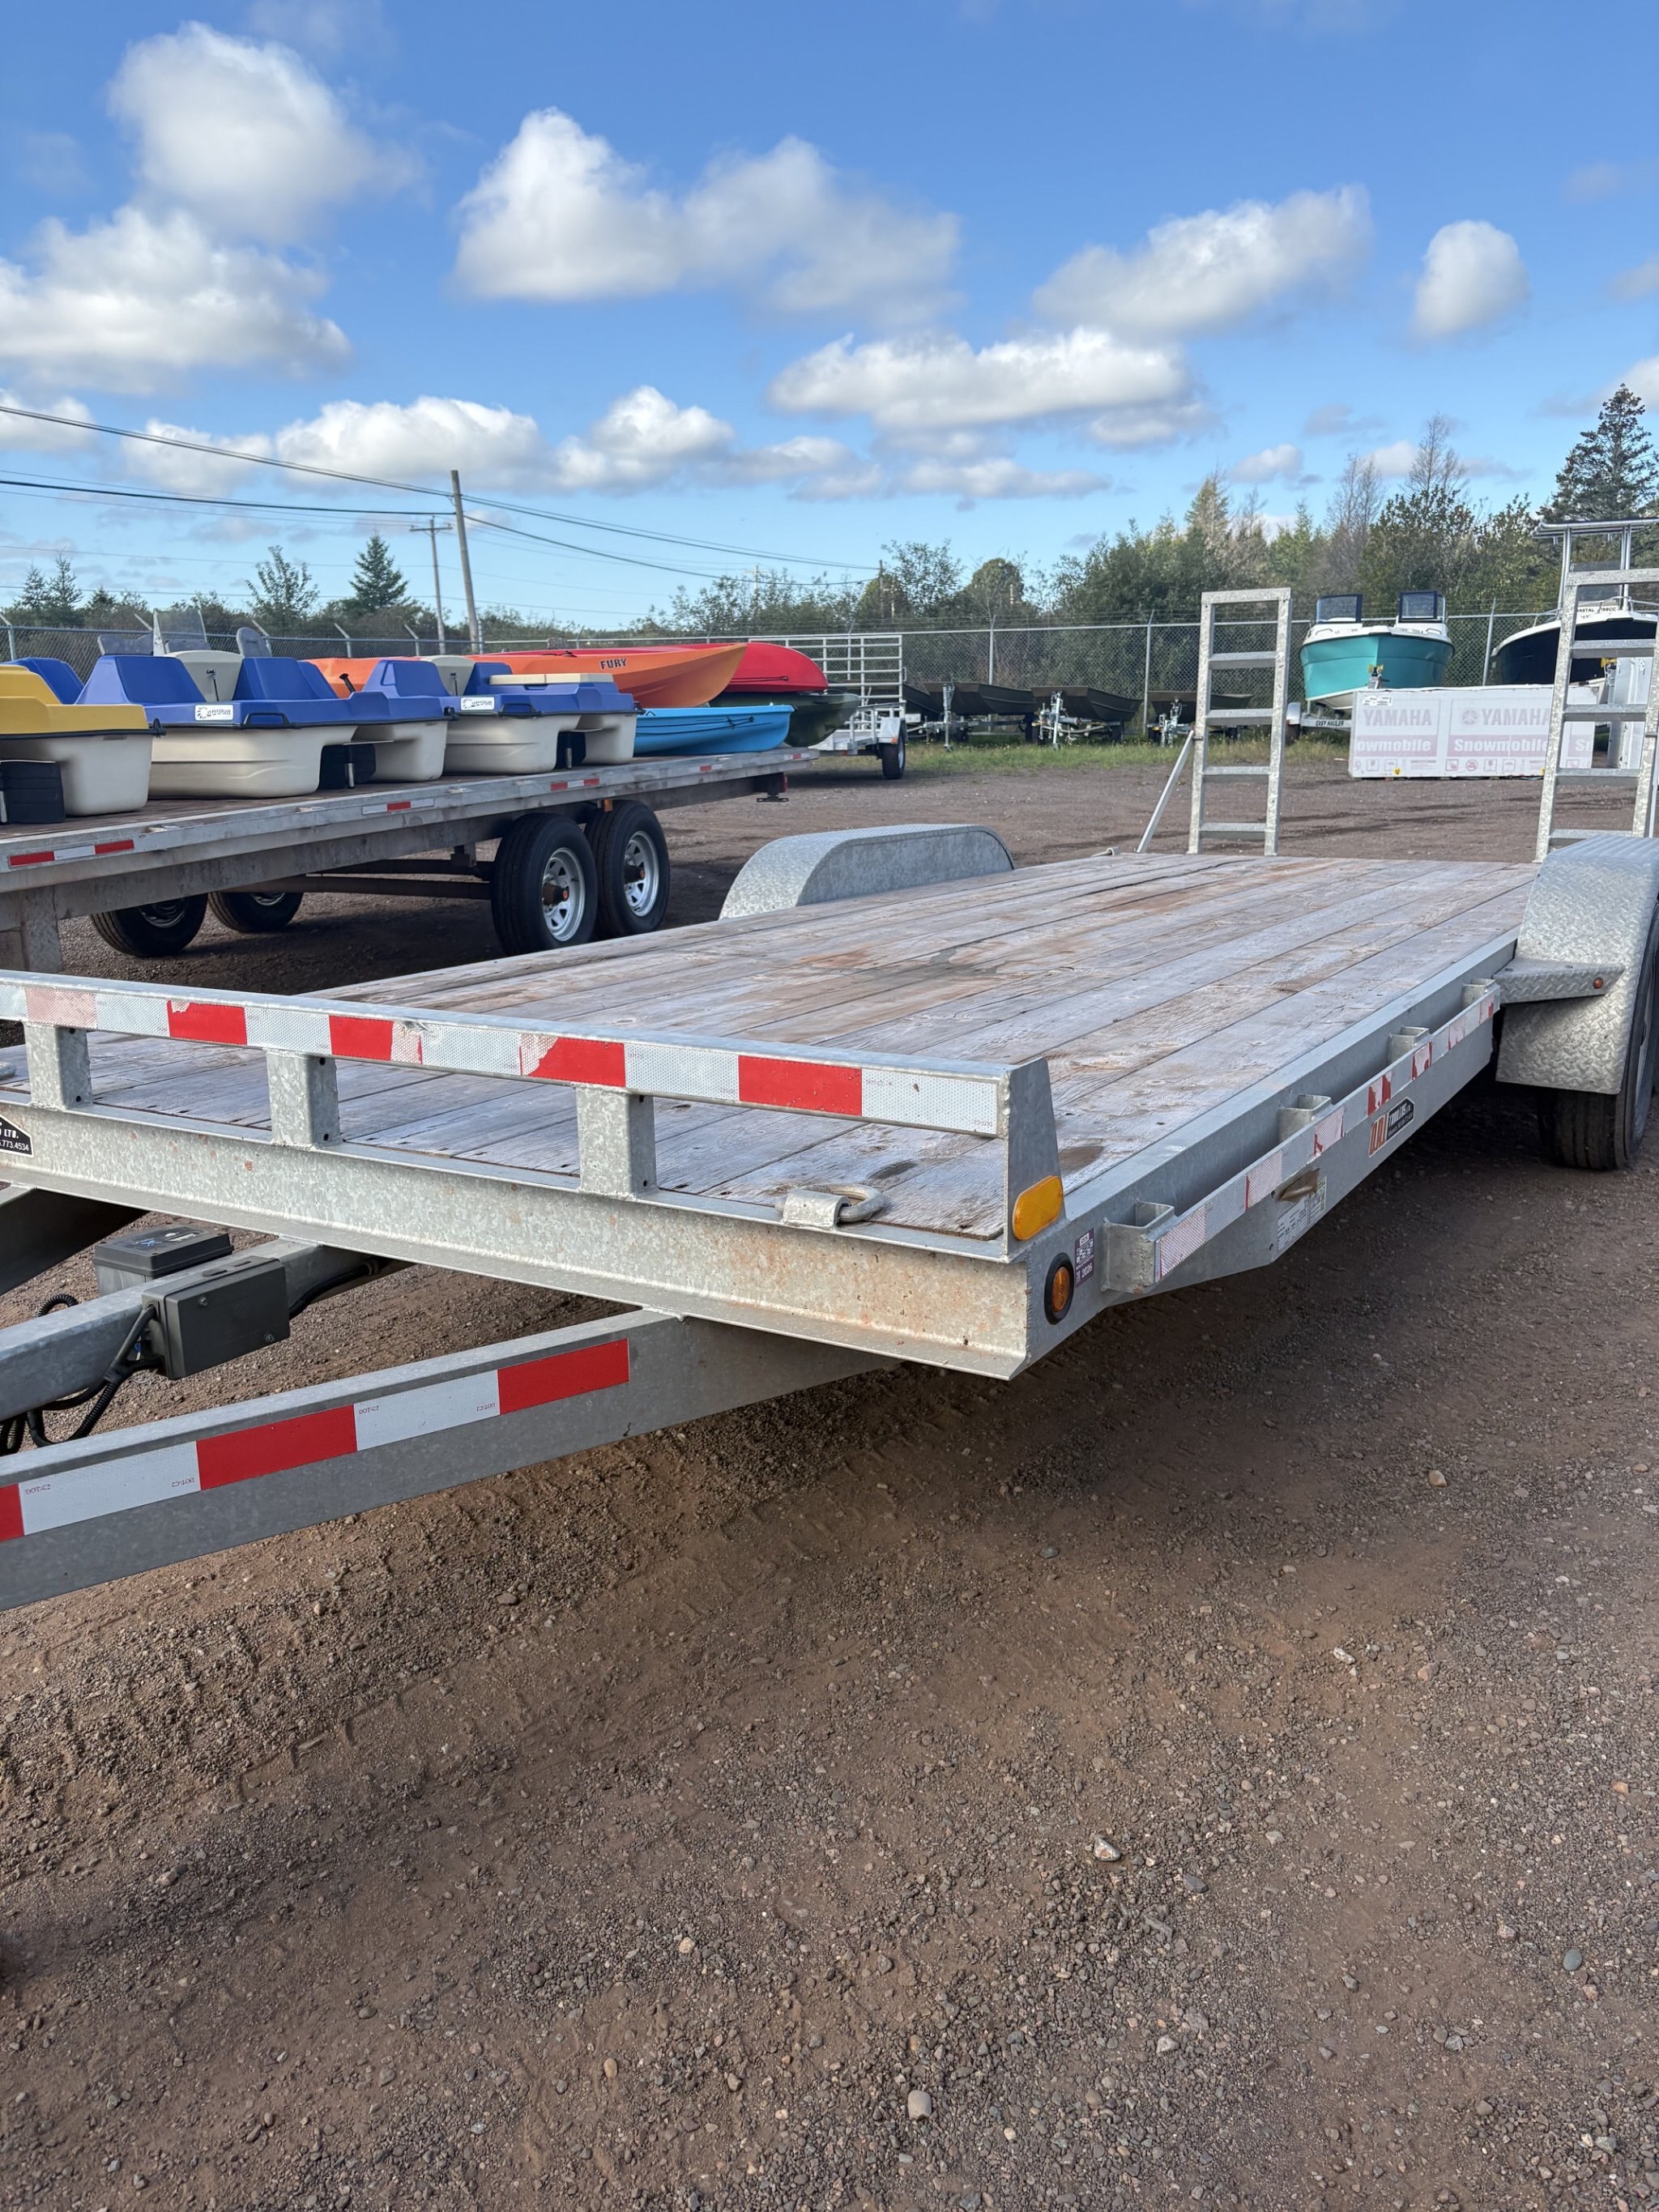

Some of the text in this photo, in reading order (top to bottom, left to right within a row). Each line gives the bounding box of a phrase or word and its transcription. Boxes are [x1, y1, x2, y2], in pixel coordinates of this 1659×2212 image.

[600, 658, 627, 670] FURY
[1363, 709, 1432, 727] YAMAHA
[1357, 738, 1431, 752] owmobile
[4, 1128, 19, 1139] LTD.
[0, 1140, 29, 1151] .773.4534
[358, 1405, 379, 1415] DOT-C2
[172, 1477, 195, 1487] DOT-C2
[25, 1484, 51, 1494] DOT-C2
